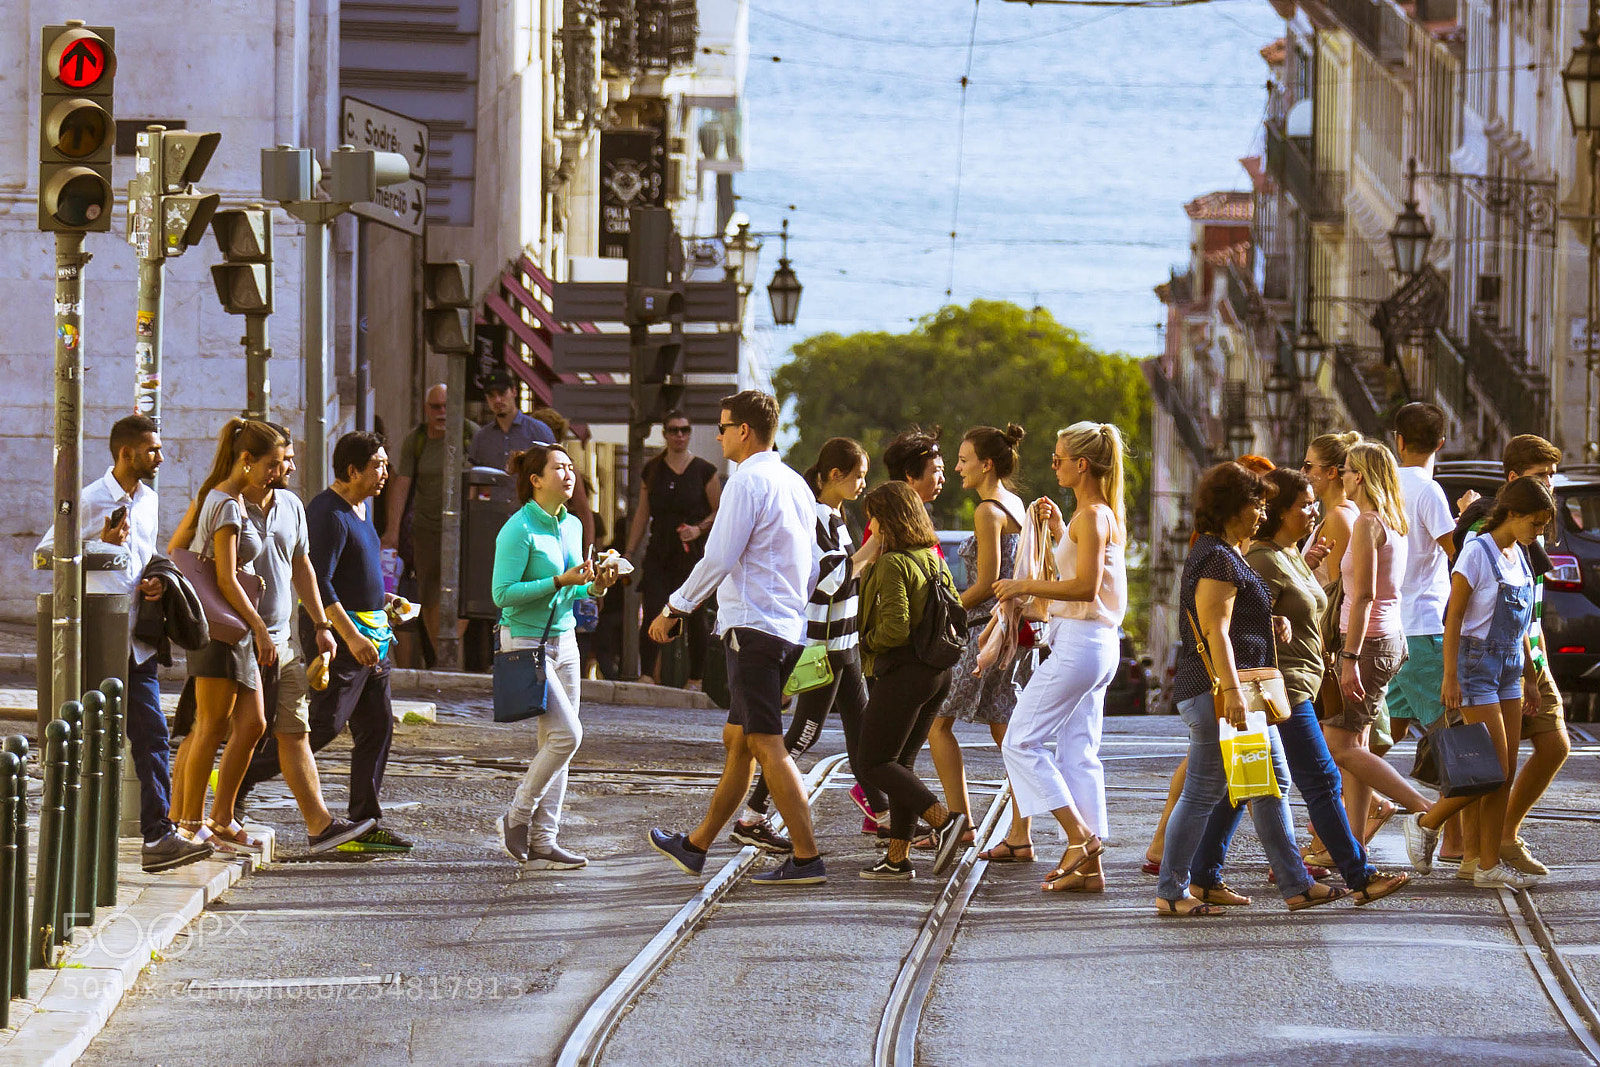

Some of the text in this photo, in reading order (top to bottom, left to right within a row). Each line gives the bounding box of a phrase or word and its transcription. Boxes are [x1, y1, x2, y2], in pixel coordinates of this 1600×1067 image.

[347, 112, 398, 153] C. Sodré
[58, 266, 77, 277] WNS
